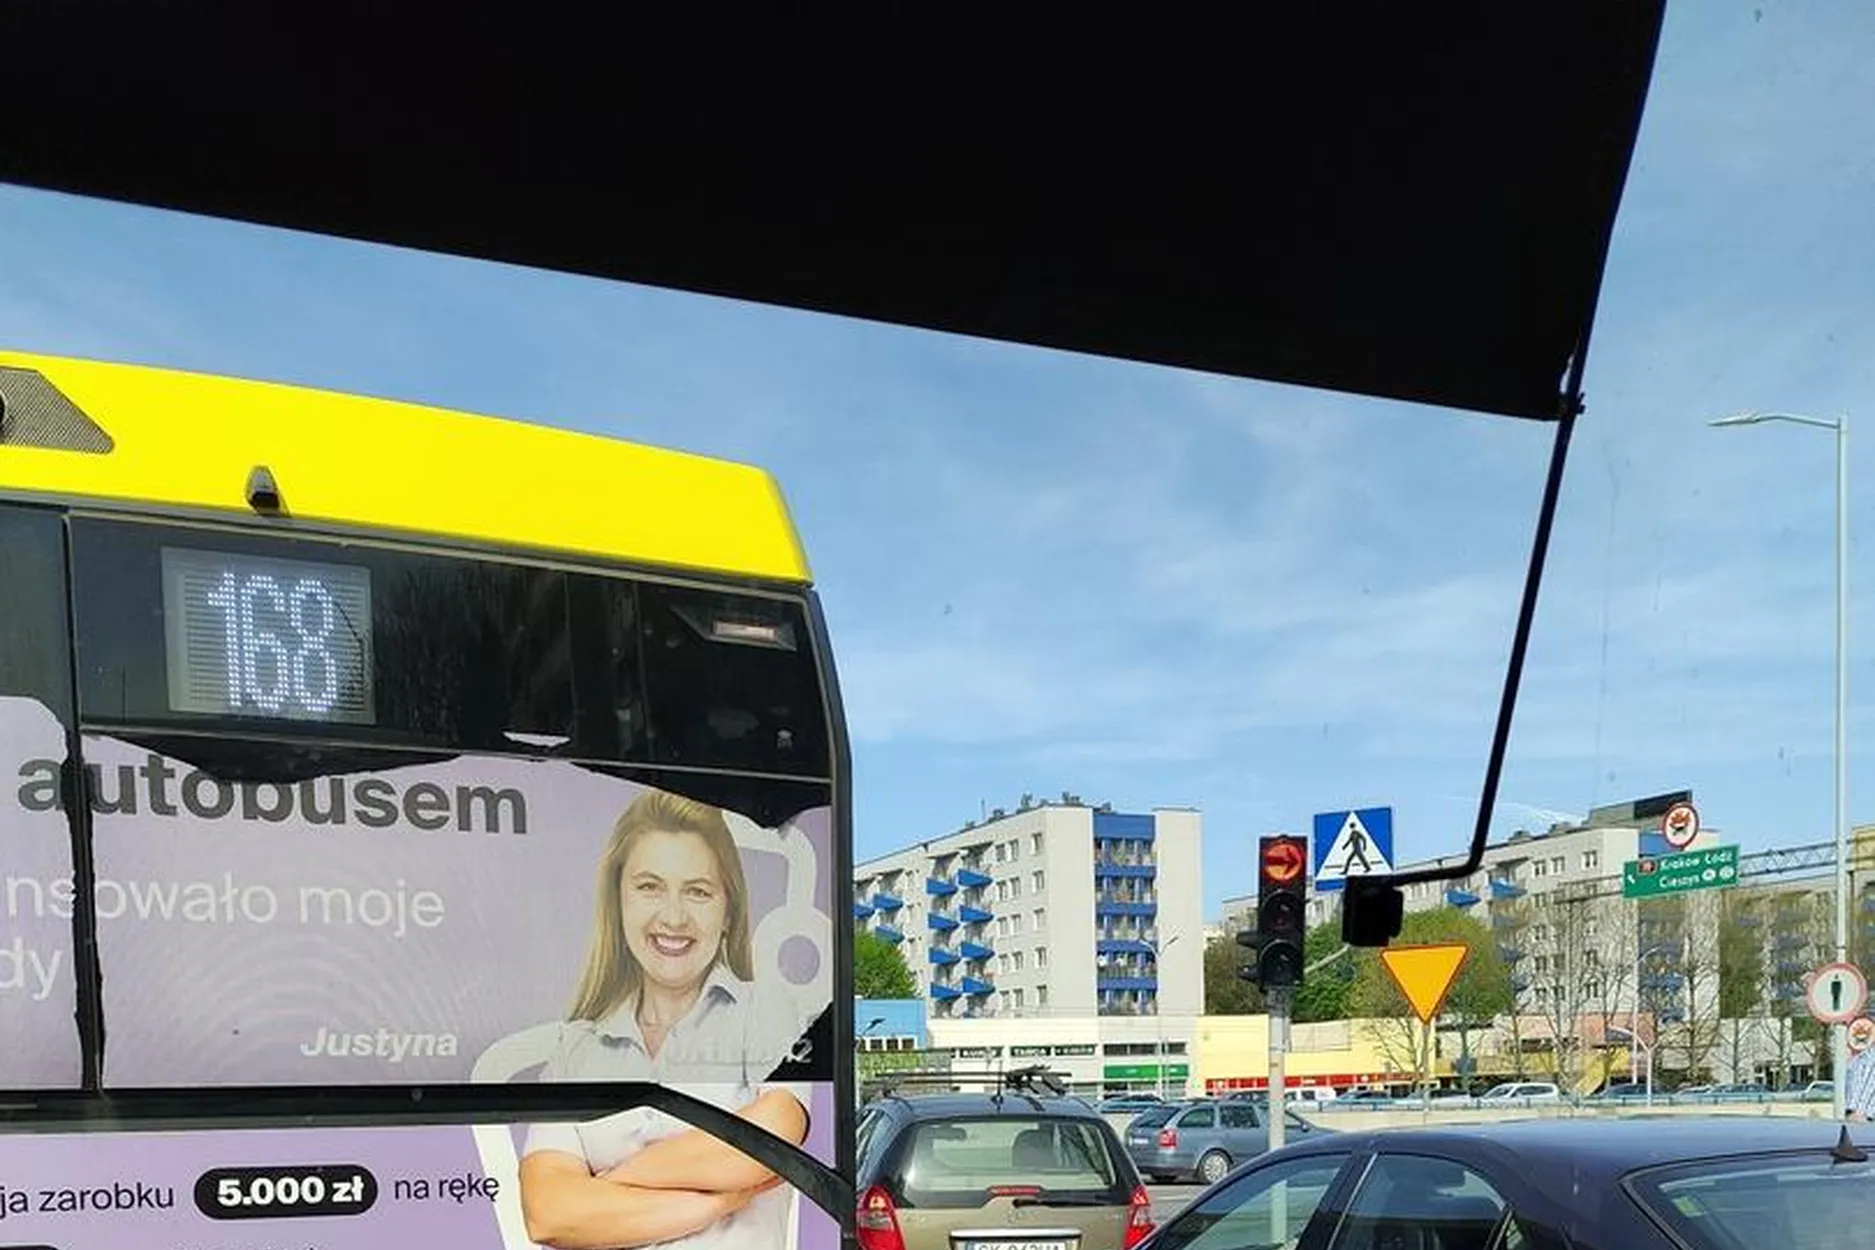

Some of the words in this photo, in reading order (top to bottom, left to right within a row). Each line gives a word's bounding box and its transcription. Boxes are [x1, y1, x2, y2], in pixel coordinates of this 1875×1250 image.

[206, 571, 338, 712] 168
[17, 754, 528, 835] autobusem
[299, 879, 446, 937] moje
[299, 1028, 459, 1065] Justyna
[39, 1182, 175, 1213] zarobku
[217, 1177, 326, 1206] 5.000
[332, 1175, 364, 1203] zł
[394, 1180, 431, 1200] na
[437, 1174, 500, 1206] rękę
